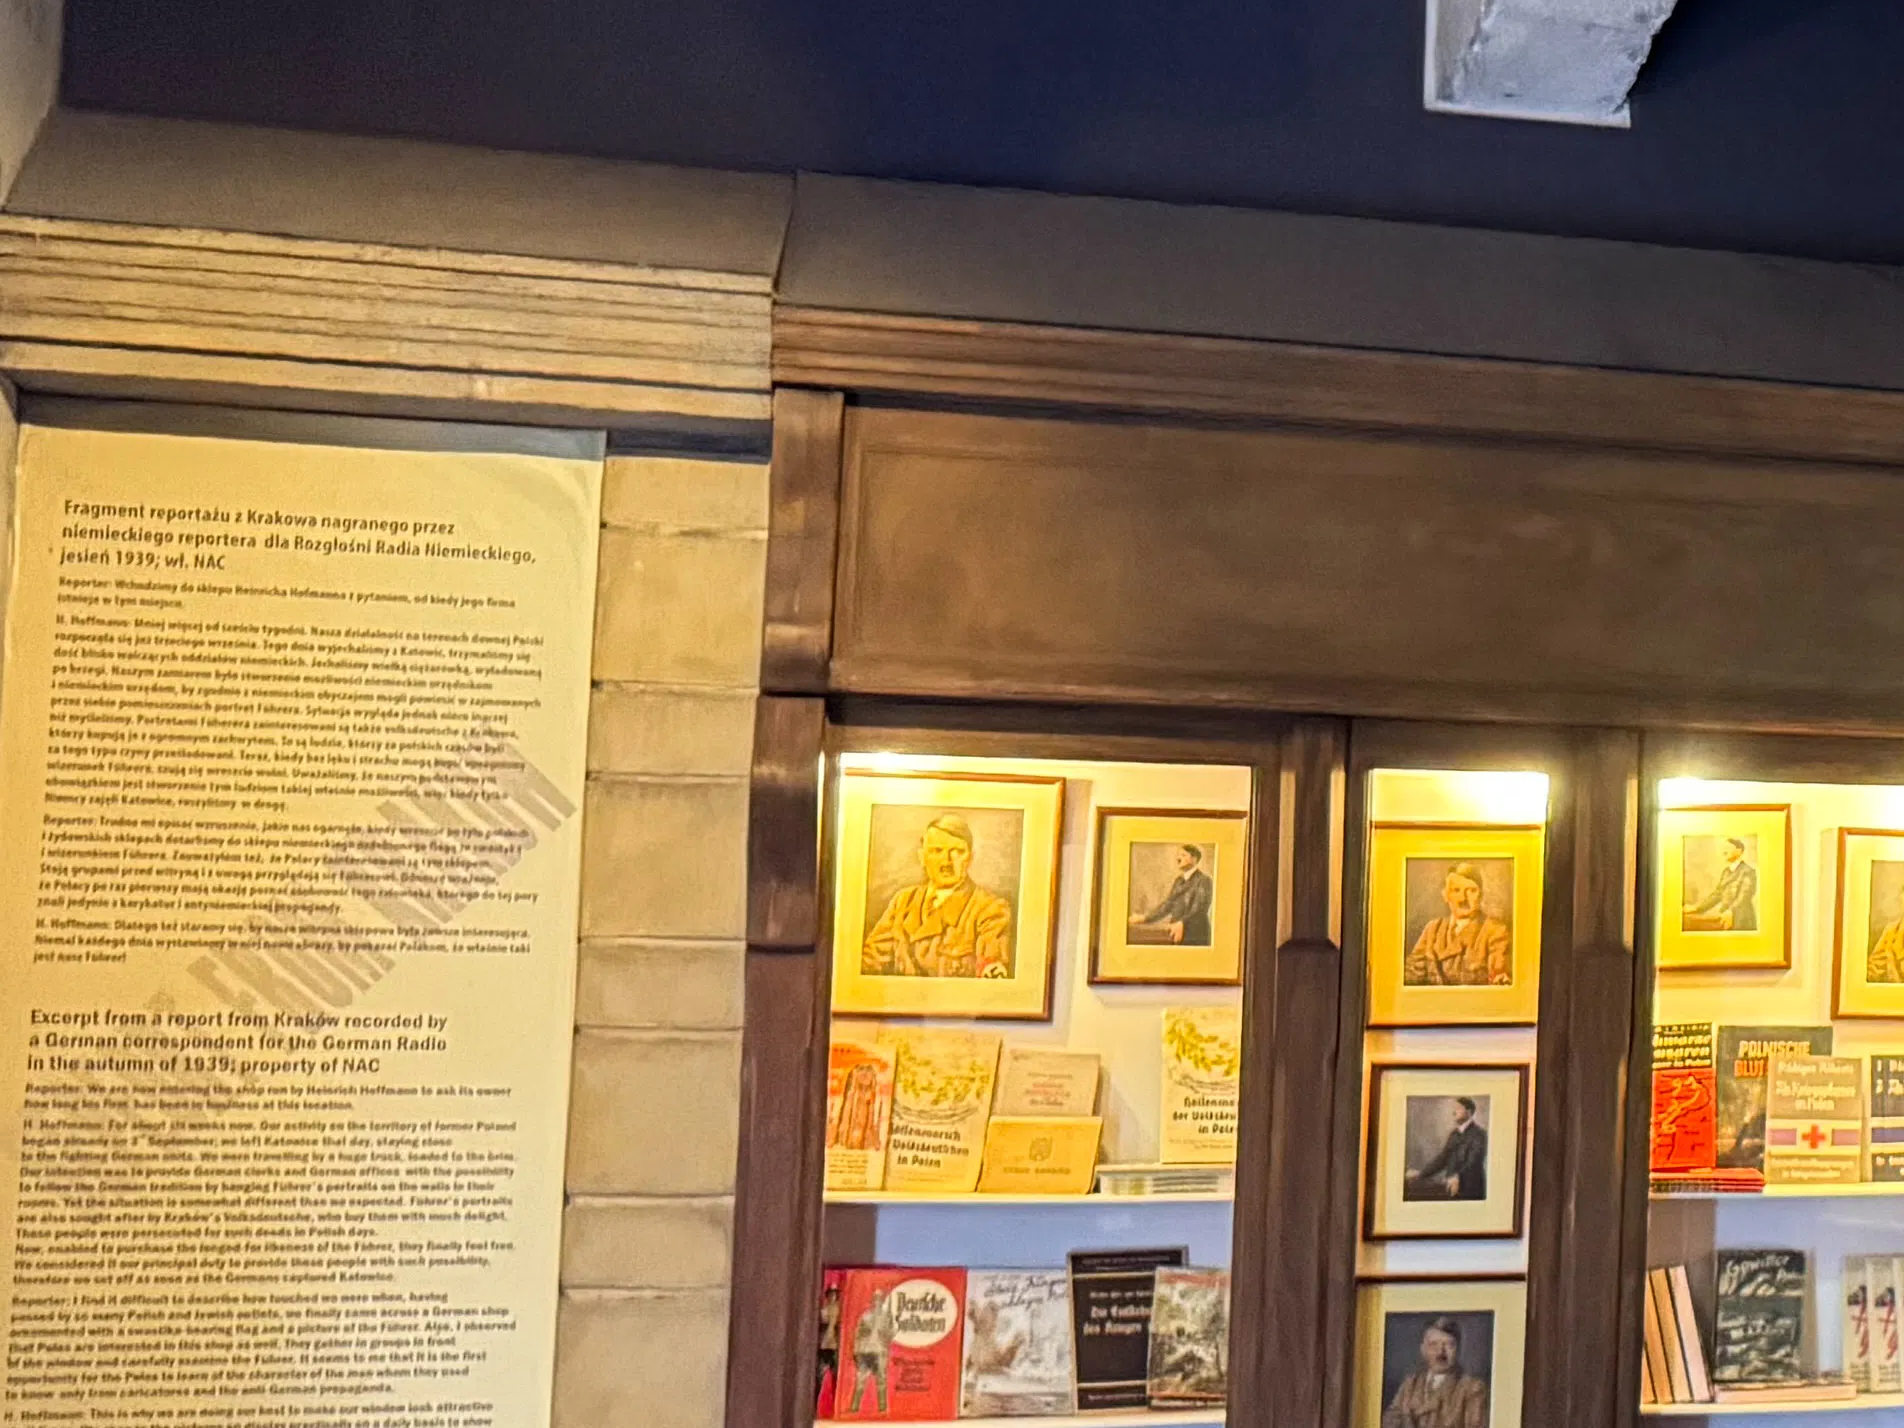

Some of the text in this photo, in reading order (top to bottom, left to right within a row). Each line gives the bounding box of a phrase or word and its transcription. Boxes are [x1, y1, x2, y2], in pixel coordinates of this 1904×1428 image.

[64, 501, 454, 536] Fragment reportażu z Krakowa nagranego przez
[62, 524, 173, 547] niemieckiego
[178, 531, 256, 549] reportera
[264, 533, 289, 550] dla
[375, 539, 420, 556] Radia
[424, 541, 536, 565] Niemieckiego,
[60, 548, 110, 566] jesień
[116, 550, 159, 570] 1939;
[193, 553, 225, 569] NAC
[30, 1010, 446, 1032] Excerpt from a report from Kraków recorded by
[28, 1033, 446, 1052] a German correspondent for the German Radio
[1738, 1039, 1811, 1059] POLNISCHE
[27, 1056, 379, 1075] in the autumn of 1939; property of NAC
[1734, 1060, 1768, 1077] BLUT
[1212, 1123, 1234, 1133] Pole
